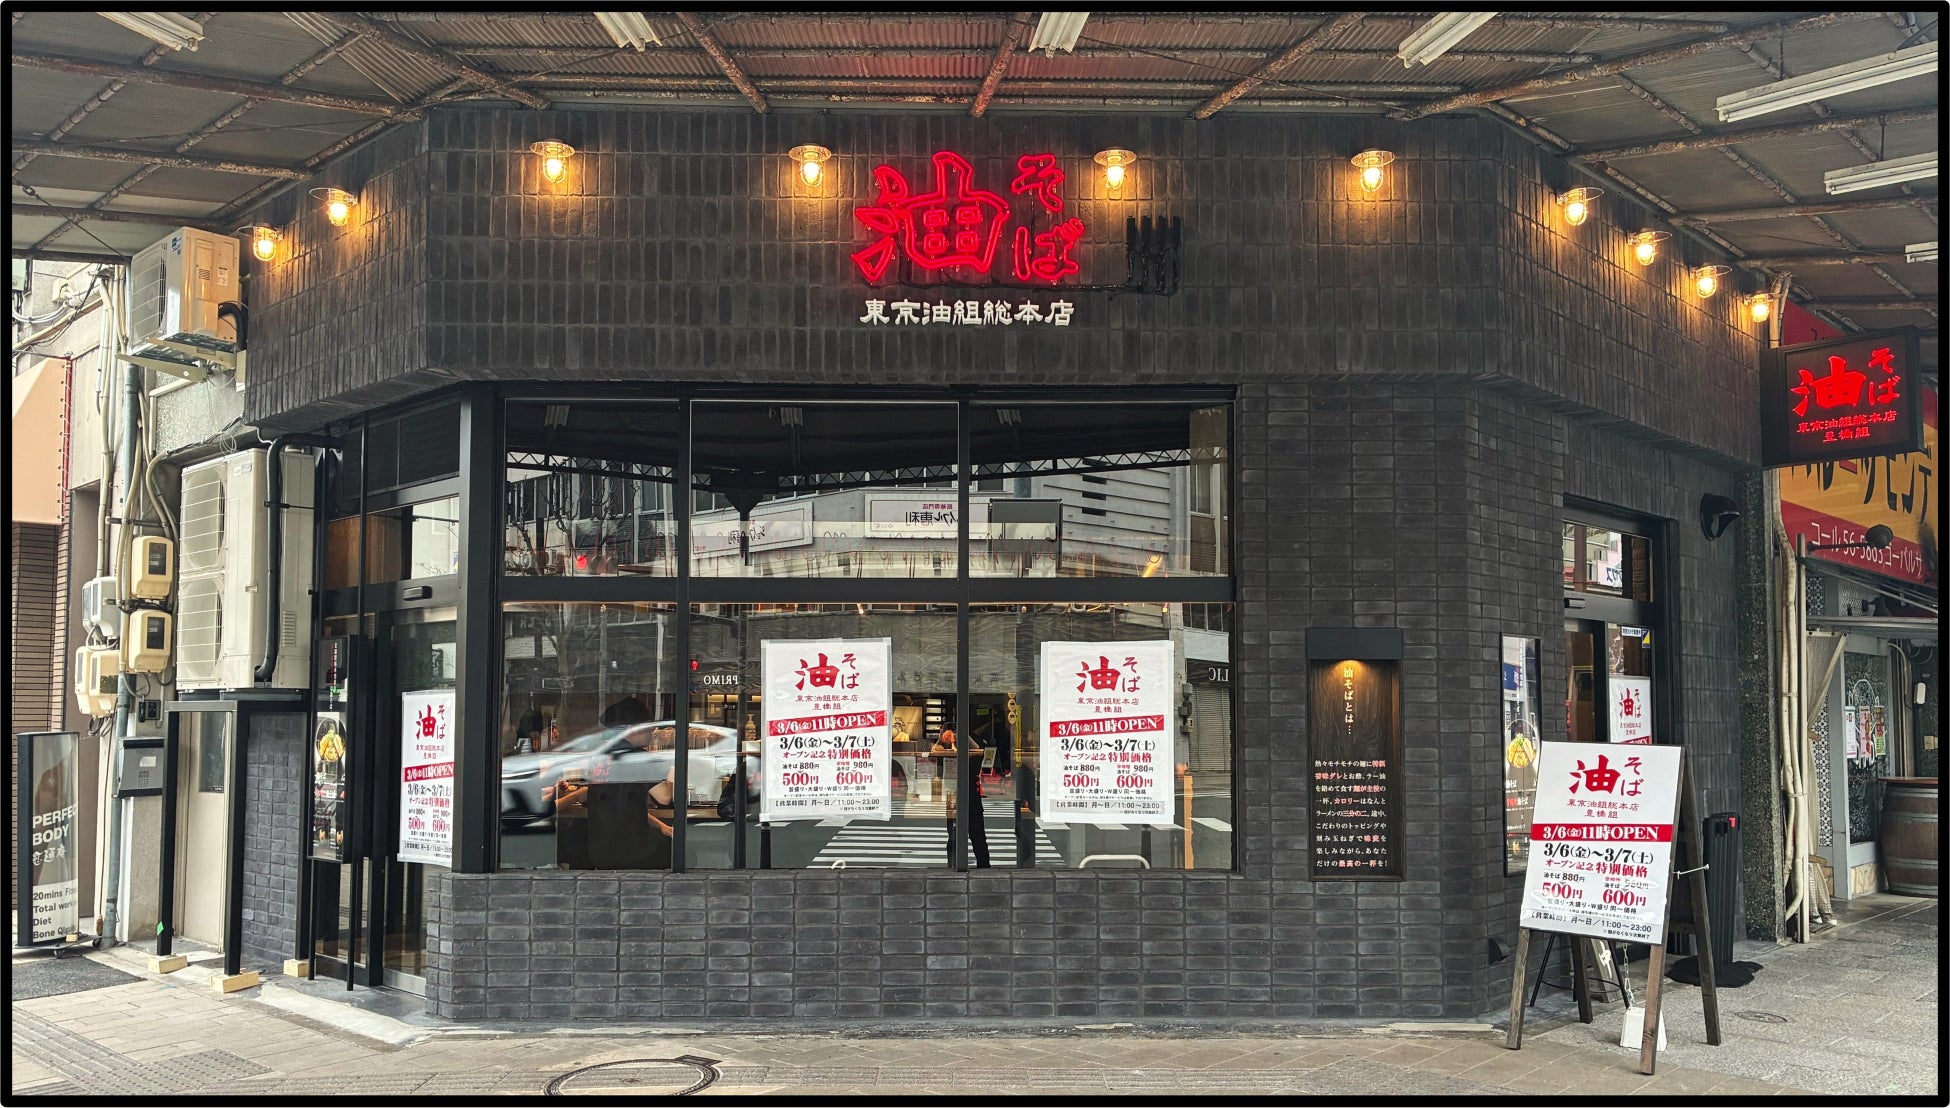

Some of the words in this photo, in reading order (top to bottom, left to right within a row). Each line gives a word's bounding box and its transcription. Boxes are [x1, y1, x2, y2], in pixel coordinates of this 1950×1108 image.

[852, 150, 1010, 281] 油
[1011, 153, 1085, 281] そば
[860, 299, 1075, 326] 東京油組総本店
[1790, 355, 1867, 417] 油
[1868, 348, 1900, 406] そば
[1796, 410, 1898, 433] 東京油組総本店
[1822, 427, 1871, 443] 豊橋組
[794, 652, 840, 691] 油
[841, 653, 860, 689] そば
[1076, 655, 1121, 693] 油
[1122, 656, 1140, 692] そば
[1619, 688, 1635, 719] 油
[415, 704, 436, 740] 油
[436, 704, 446, 740] そば
[782, 772, 819, 786] 500円
[836, 771, 873, 786] 600円
[1063, 774, 1099, 788] 500円
[1116, 774, 1153, 788] 600円
[1568, 754, 1621, 794] 油
[1621, 756, 1645, 796] そば
[1567, 799, 1640, 811] 東京油組総本店
[32, 823, 69, 846] BODY
[33, 890, 63, 901] 20mins
[1541, 882, 1583, 899] 500円
[1603, 889, 1646, 906] 600円
[33, 902, 56, 913] Total
[33, 917, 52, 926] Diet
[33, 930, 55, 939] Bone
